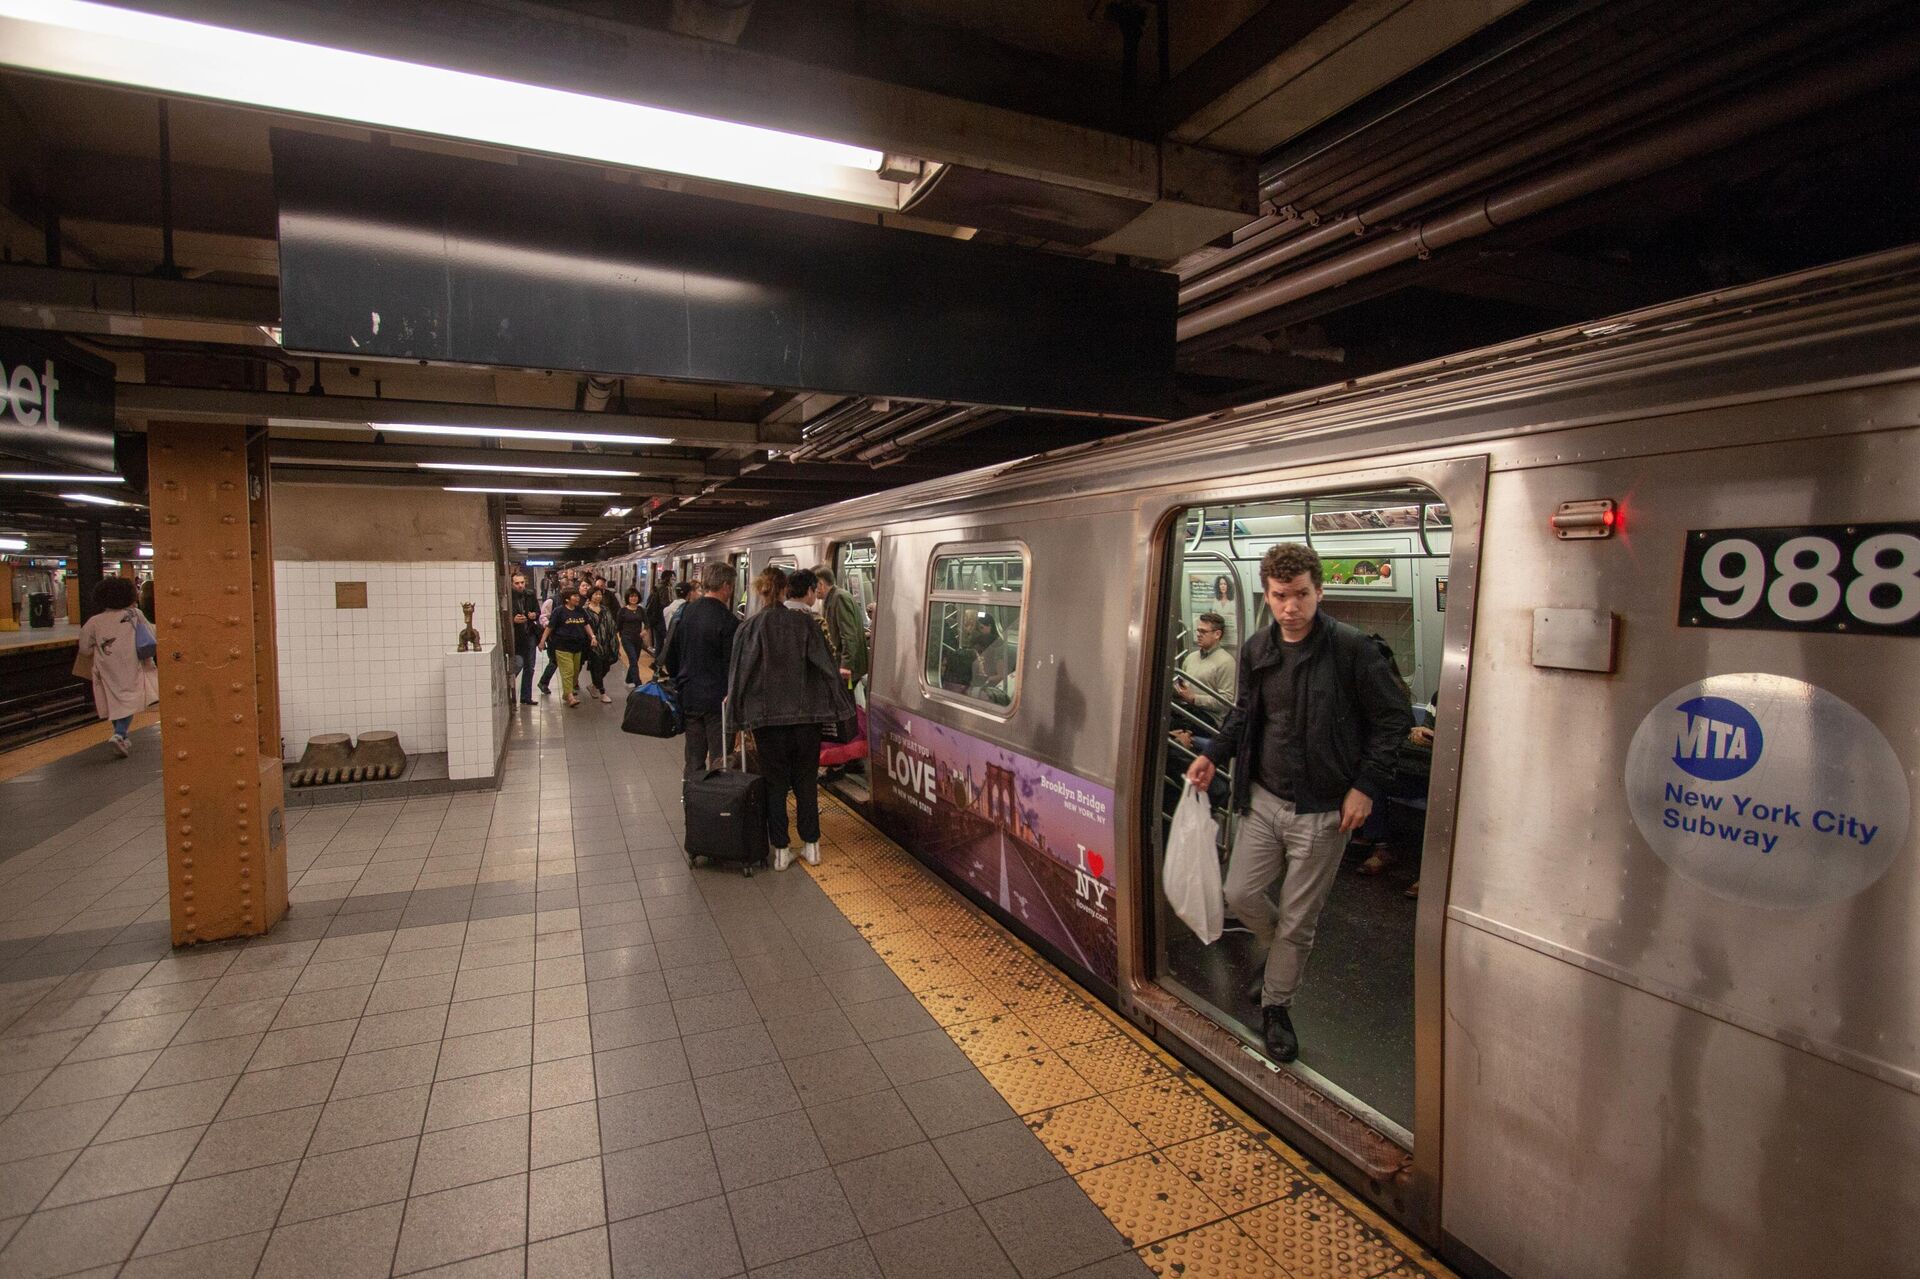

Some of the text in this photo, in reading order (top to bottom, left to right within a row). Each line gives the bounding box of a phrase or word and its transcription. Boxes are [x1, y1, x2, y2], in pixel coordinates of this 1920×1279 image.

[0, 359, 60, 432] et
[1700, 533, 1920, 624] 988
[1675, 711, 1748, 760] MTA
[887, 745, 937, 803] LOVE
[1040, 775, 1106, 813] Brooklyn Bridge
[1064, 800, 1077, 813] NEW
[1097, 815, 1106, 825] NY
[1663, 808, 1779, 853] Subway
[1664, 782, 1878, 845] New York City
[1077, 843, 1087, 871] I
[1075, 869, 1109, 910] NY
